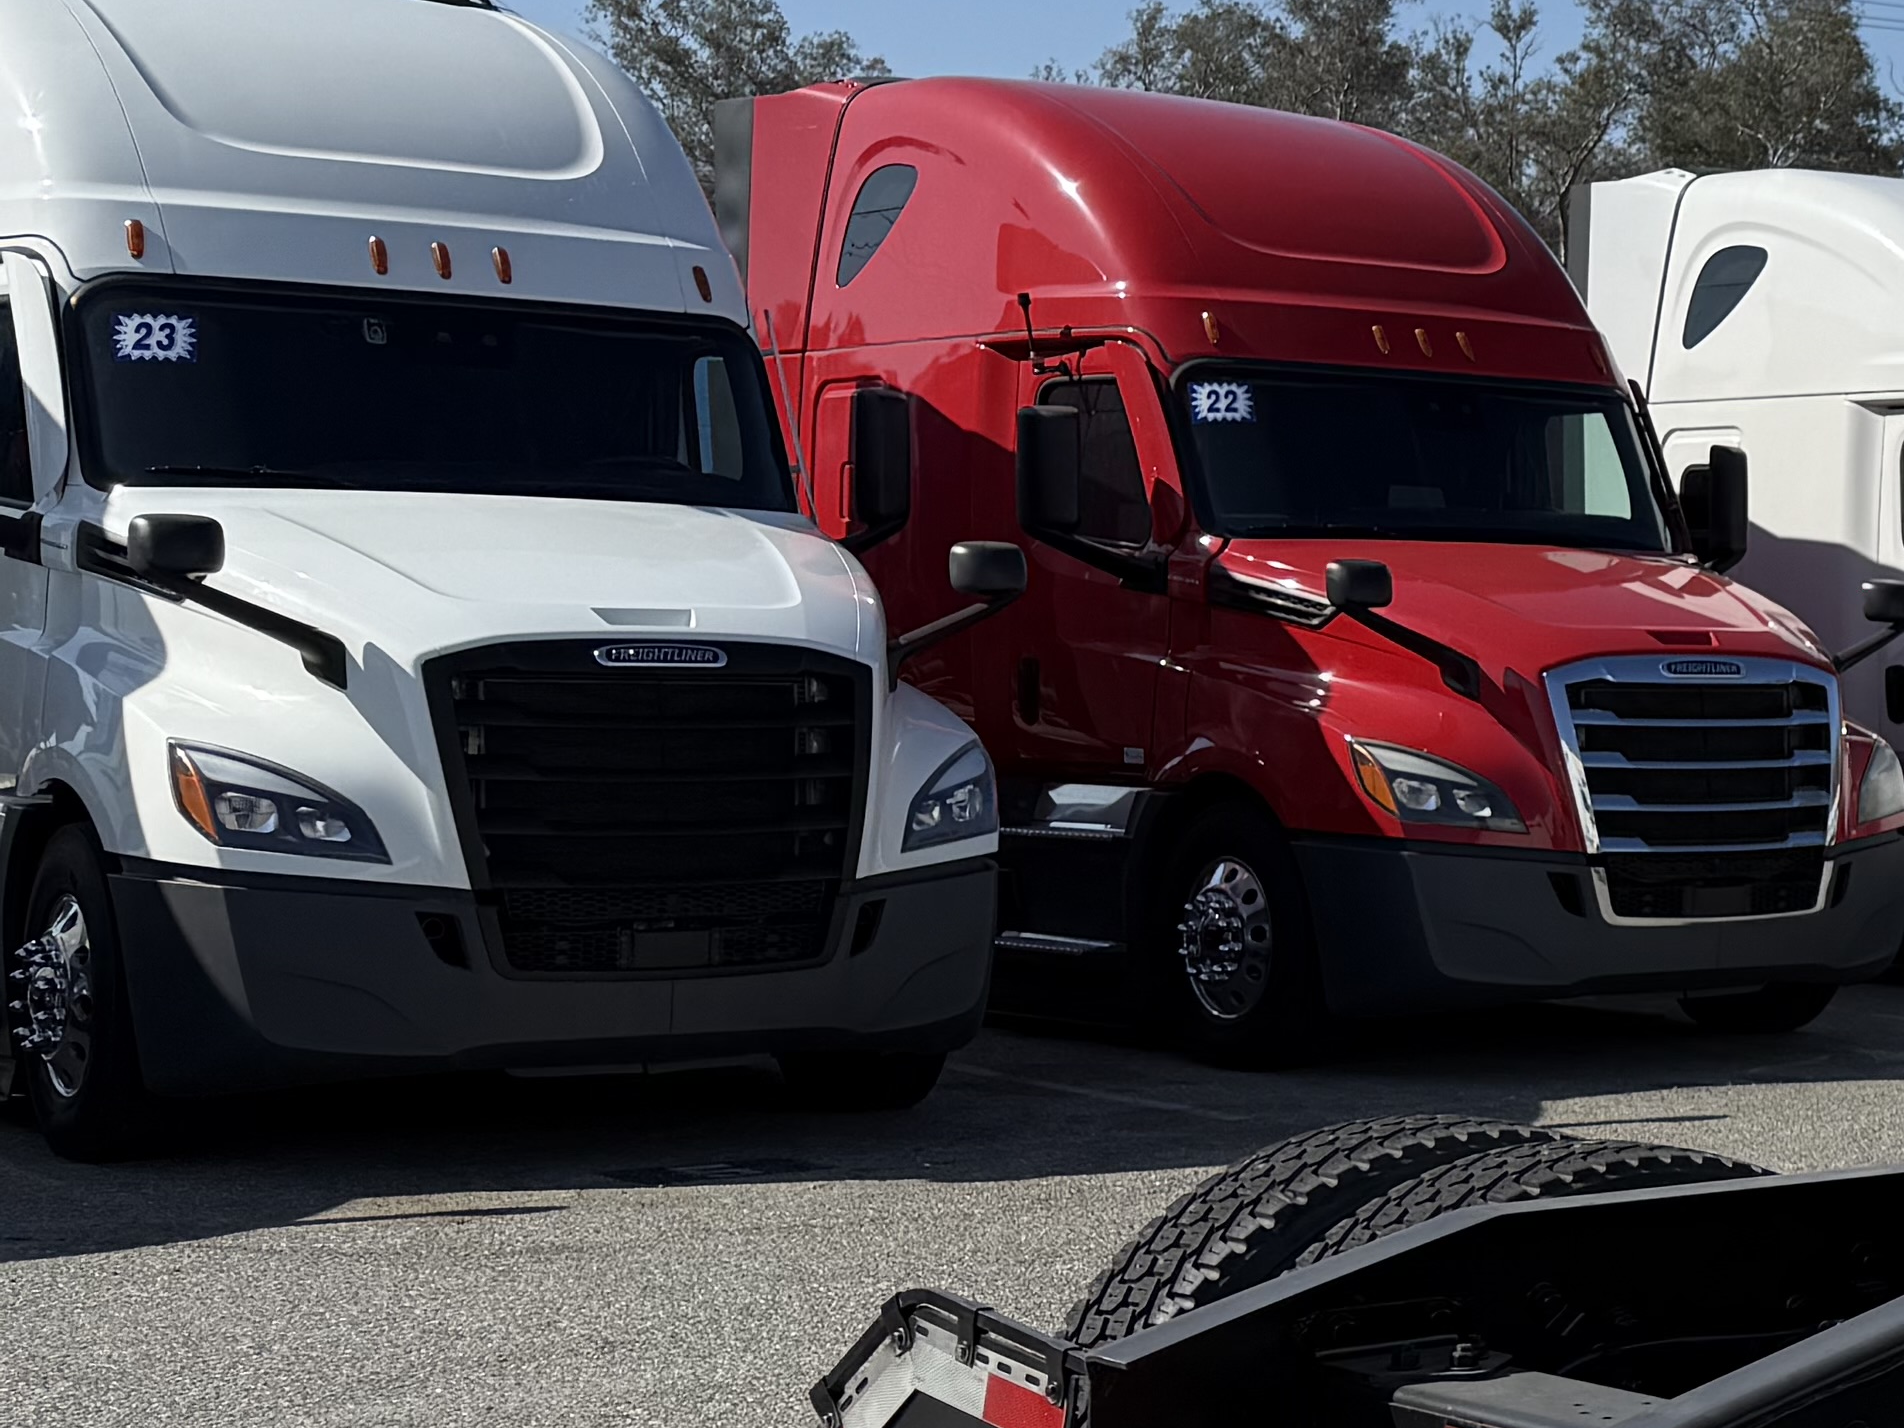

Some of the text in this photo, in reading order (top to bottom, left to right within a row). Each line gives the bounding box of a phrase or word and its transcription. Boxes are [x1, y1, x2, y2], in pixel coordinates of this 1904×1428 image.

[131, 321, 176, 351] 23
[1206, 389, 1239, 414] 22
[611, 647, 714, 662] FREIGHTLINER
